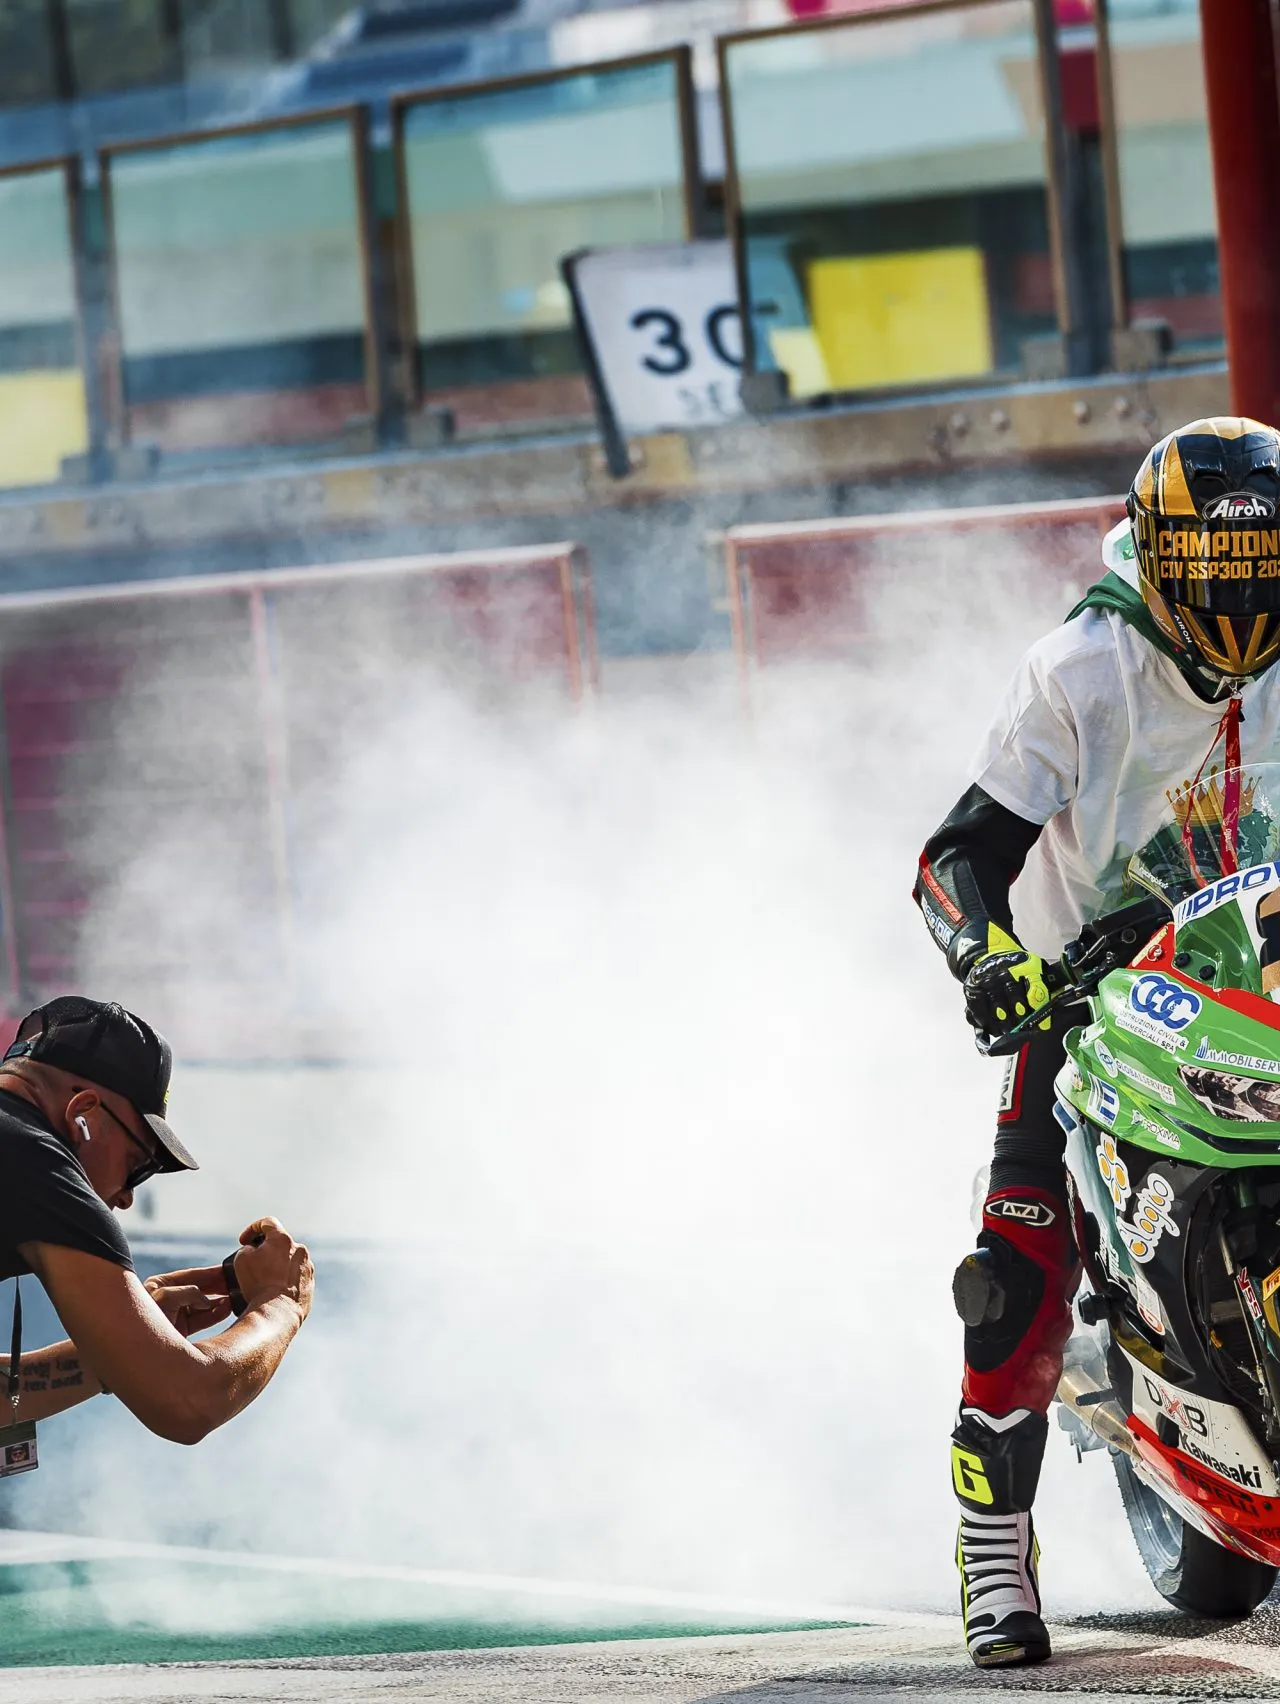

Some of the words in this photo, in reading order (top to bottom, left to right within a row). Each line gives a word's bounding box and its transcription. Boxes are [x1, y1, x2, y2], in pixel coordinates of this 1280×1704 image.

[1210, 498, 1268, 518] Airoh
[1160, 561, 1184, 580] CIV
[1188, 561, 1253, 580] SSP300
[1174, 614, 1192, 643] AIROH
[1116, 1019, 1159, 1044] COMMERCIALI
[1160, 1040, 1174, 1051] SPA
[1158, 1029, 1178, 1044] CIVILI
[1141, 1119, 1180, 1143] PROXIMA
[1178, 1430, 1262, 1489] Kawasaki
[951, 1445, 994, 1505] G
